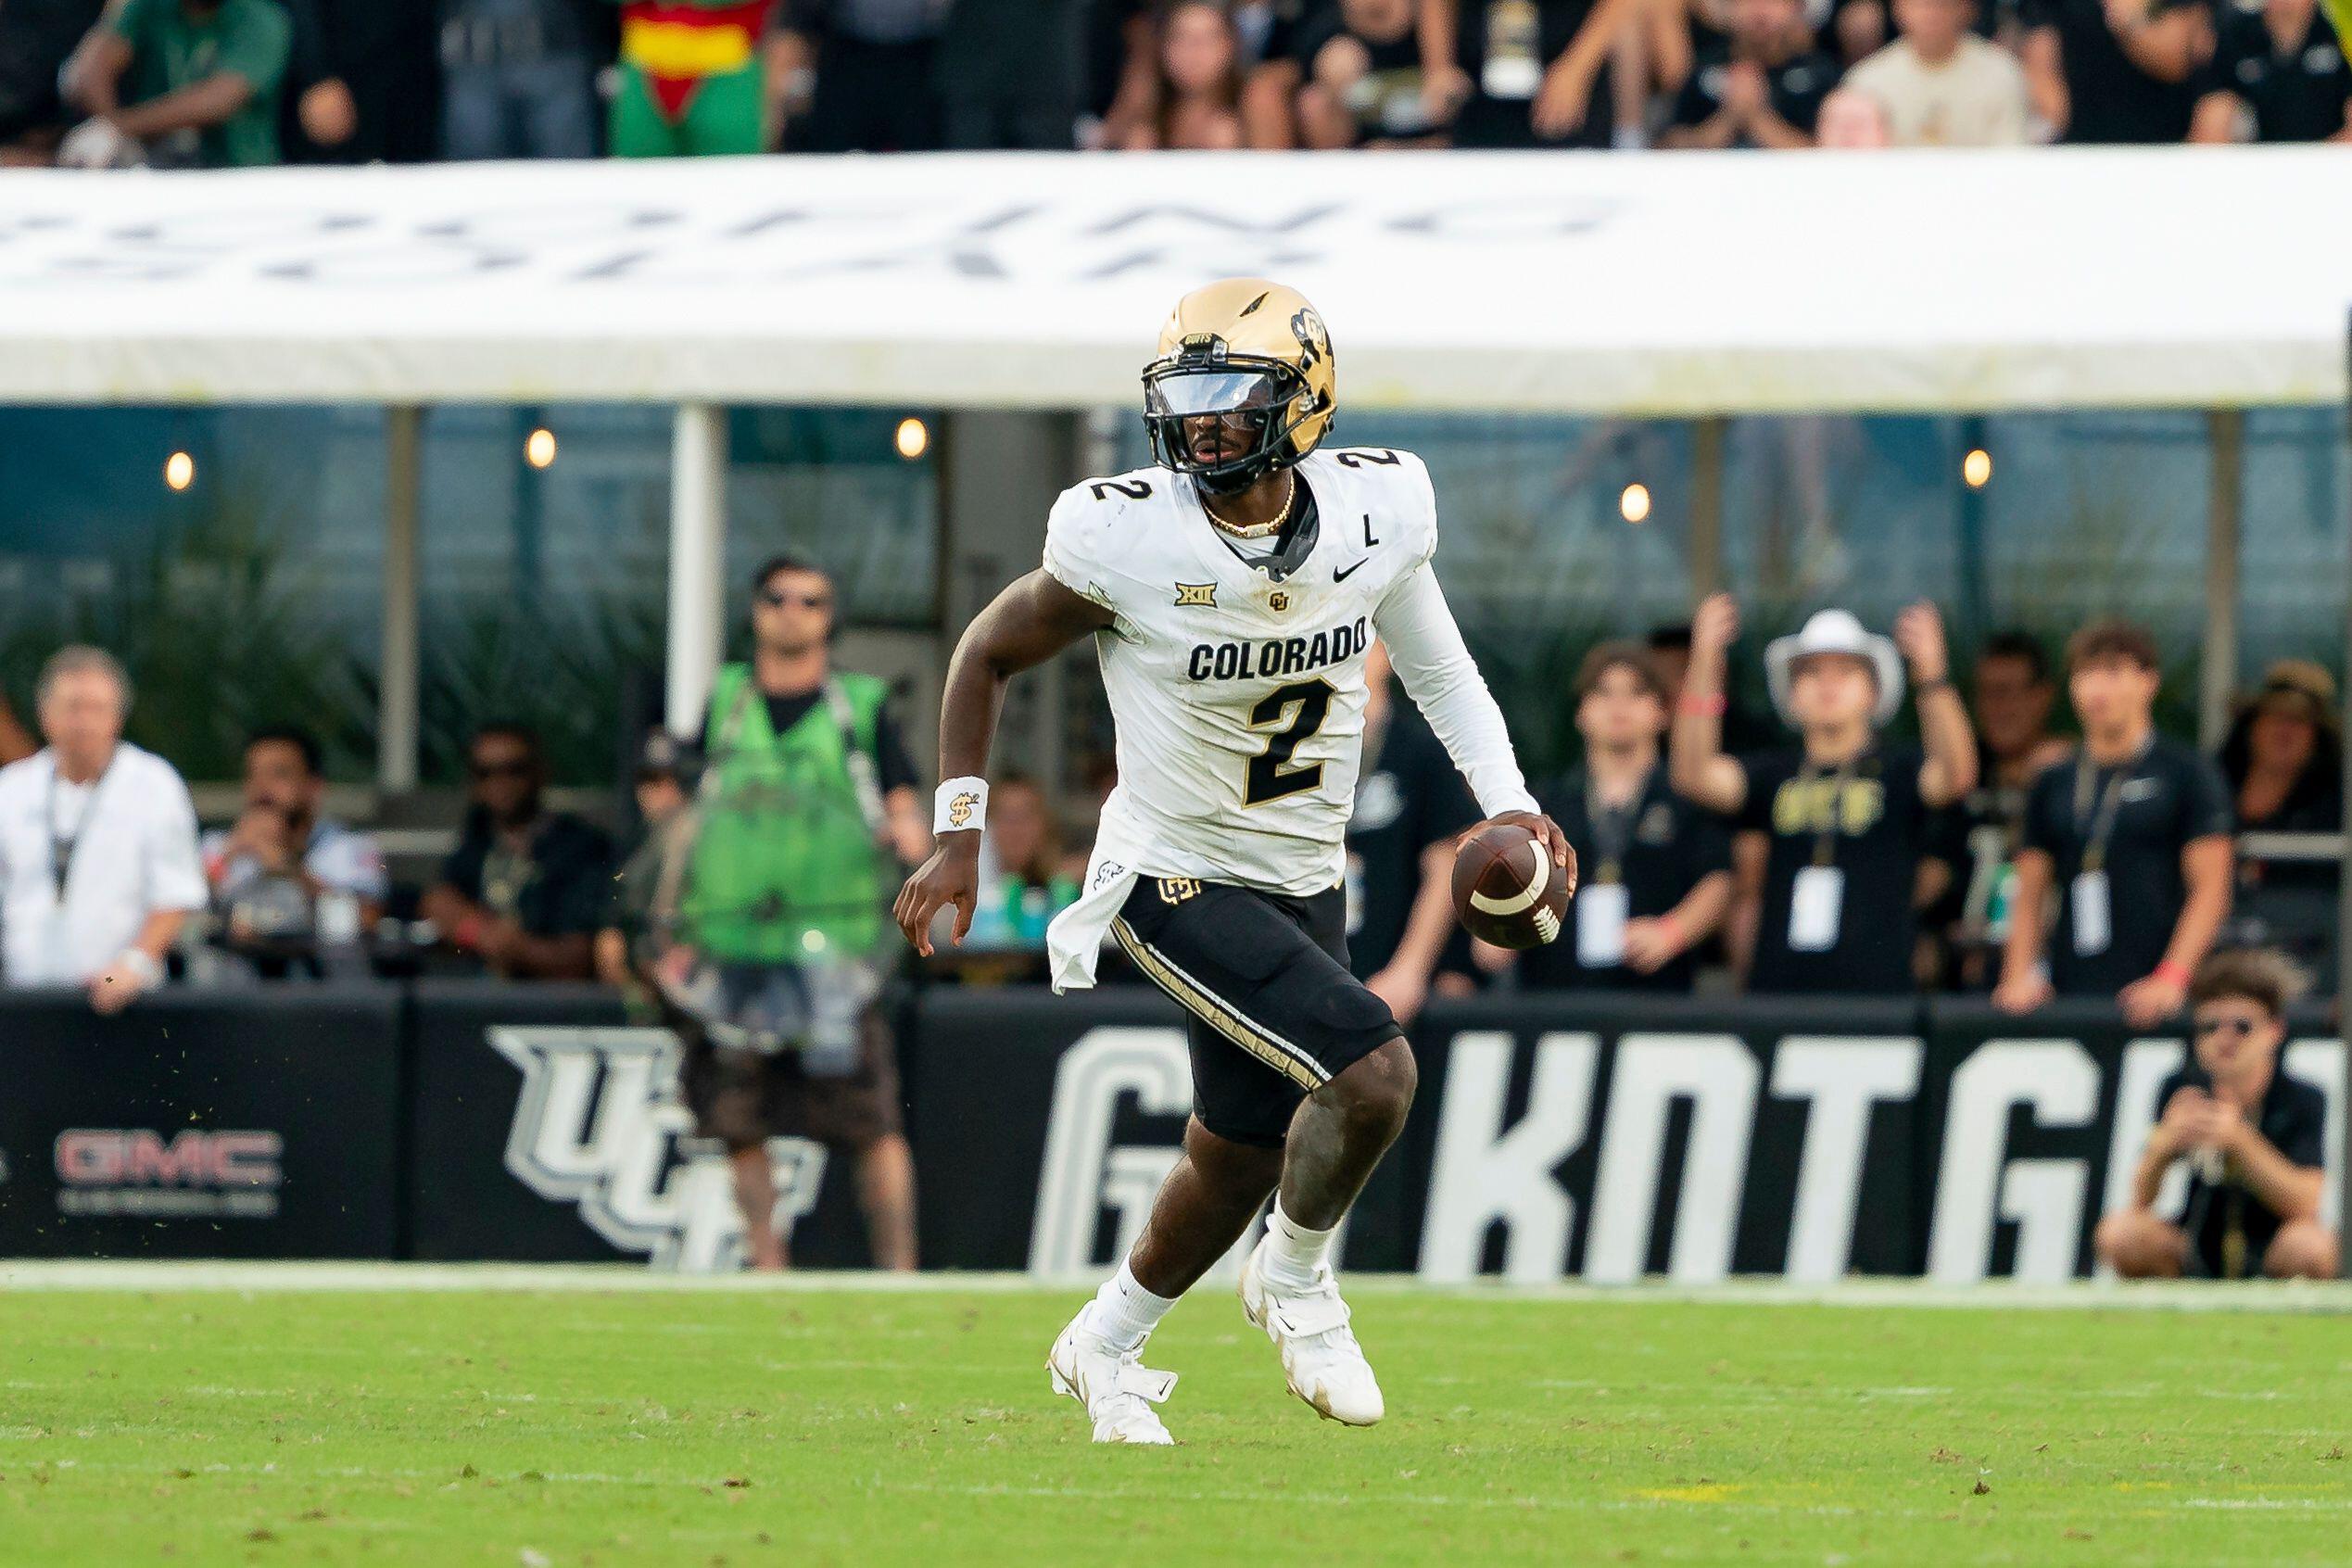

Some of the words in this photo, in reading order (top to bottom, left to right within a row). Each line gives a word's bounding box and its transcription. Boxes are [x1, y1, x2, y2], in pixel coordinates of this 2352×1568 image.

[1339, 449, 1402, 470] 2
[1092, 479, 1154, 501] 2
[1362, 513, 1380, 548] L
[1187, 615, 1368, 682] COLORADO
[1242, 676, 1338, 809] 2
[55, 1128, 284, 1185] GMC
